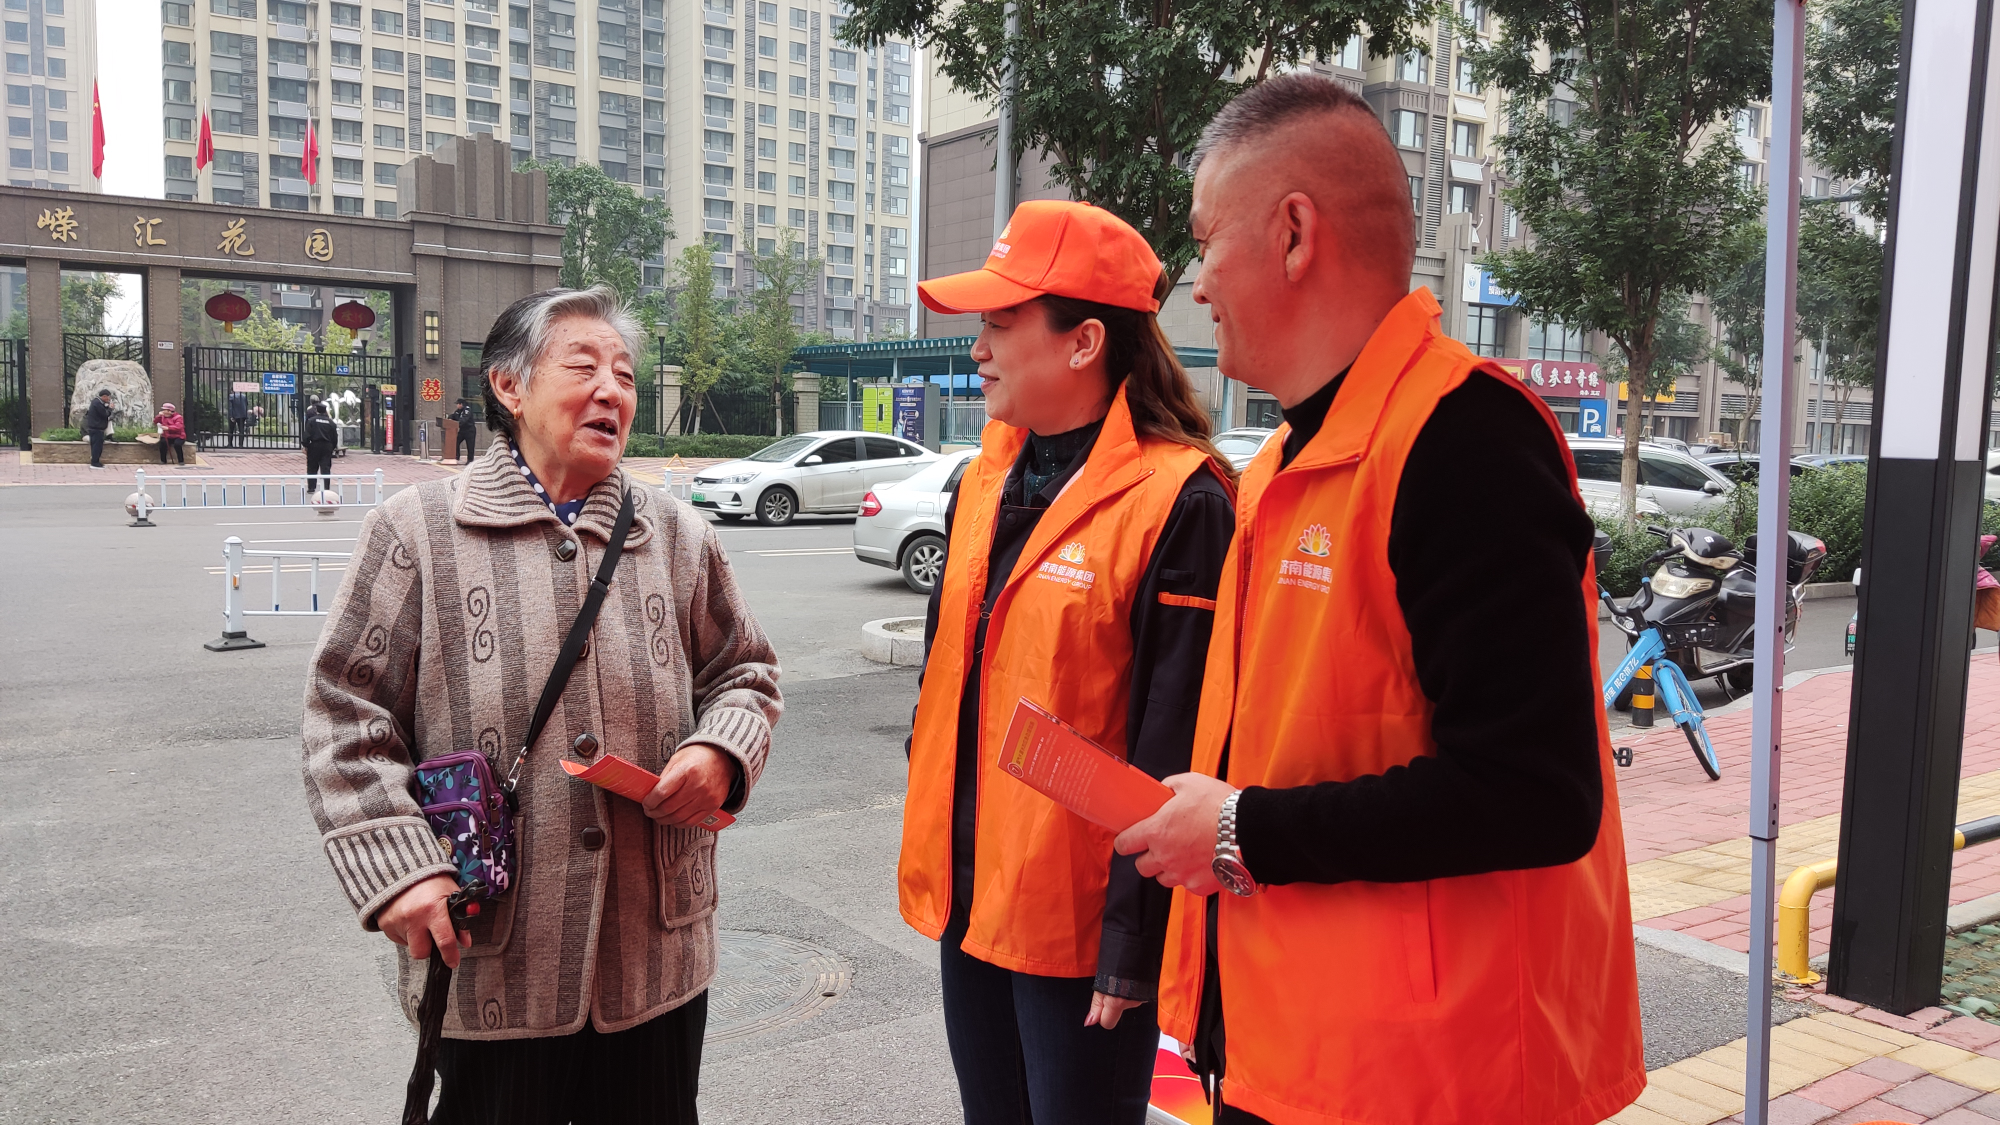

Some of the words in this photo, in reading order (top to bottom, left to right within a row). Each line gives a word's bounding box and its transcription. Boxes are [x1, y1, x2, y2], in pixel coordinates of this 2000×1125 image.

[37, 205, 334, 262] 嵘汇花园
[1582, 408, 1600, 433] P
[1039, 561, 1095, 583] 济南能源集团
[1051, 575, 1071, 584] ENERGY
[1071, 580, 1092, 590] GROUP
[1279, 559, 1333, 584] 济南能源集
[1604, 686, 1616, 705] 付宝
